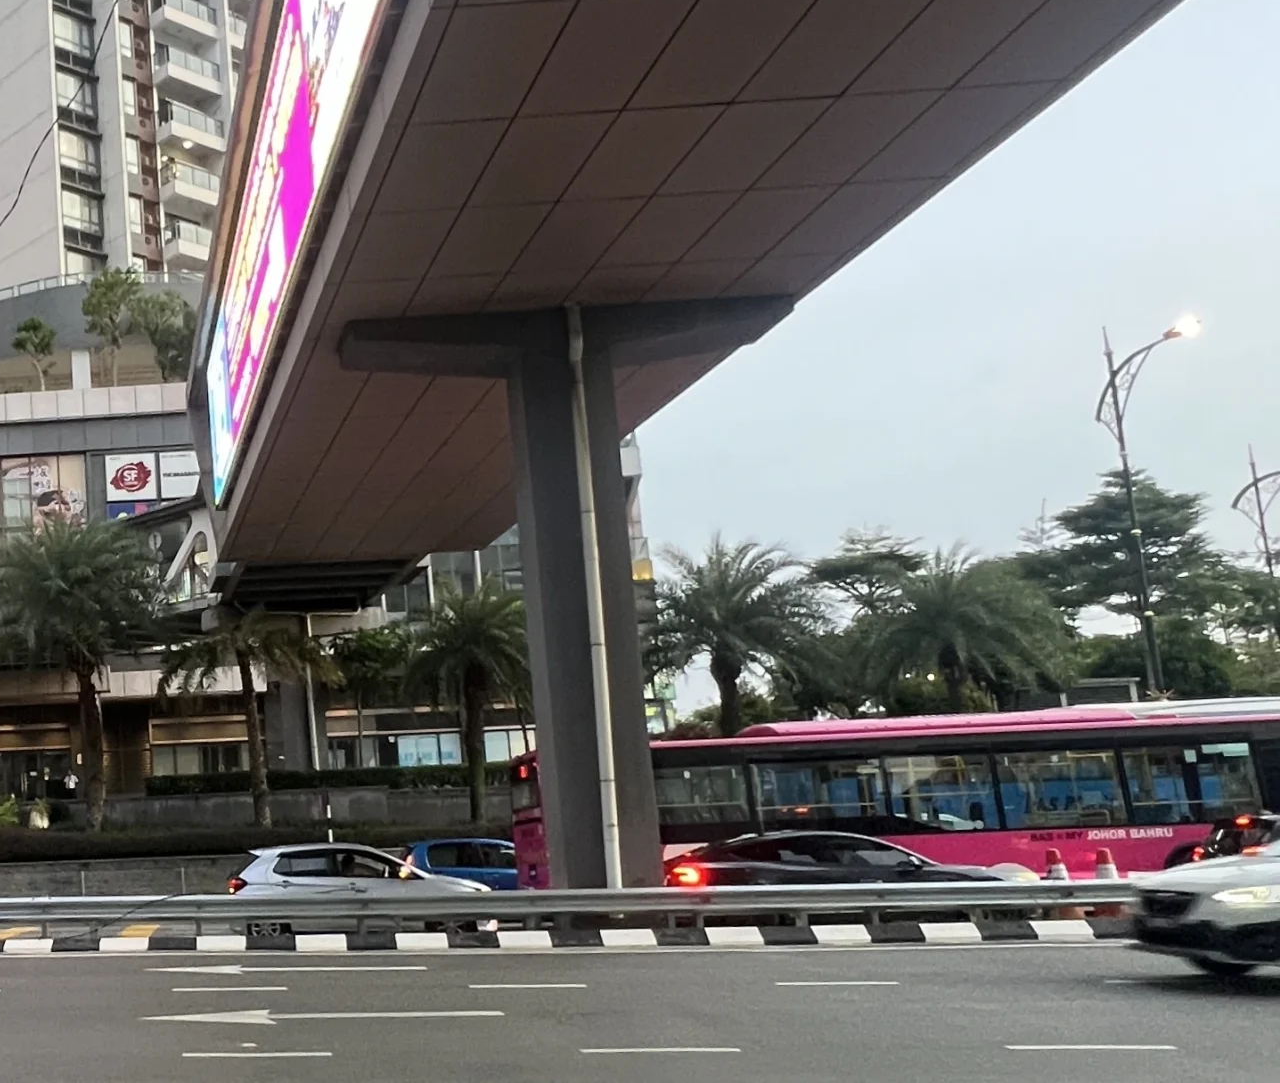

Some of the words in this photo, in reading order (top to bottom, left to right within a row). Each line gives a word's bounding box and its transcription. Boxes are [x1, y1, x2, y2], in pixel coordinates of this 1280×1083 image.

[122, 469, 139, 482] SF
[1086, 829, 1126, 840] JOHOR
[1130, 827, 1173, 838] BAHRU
